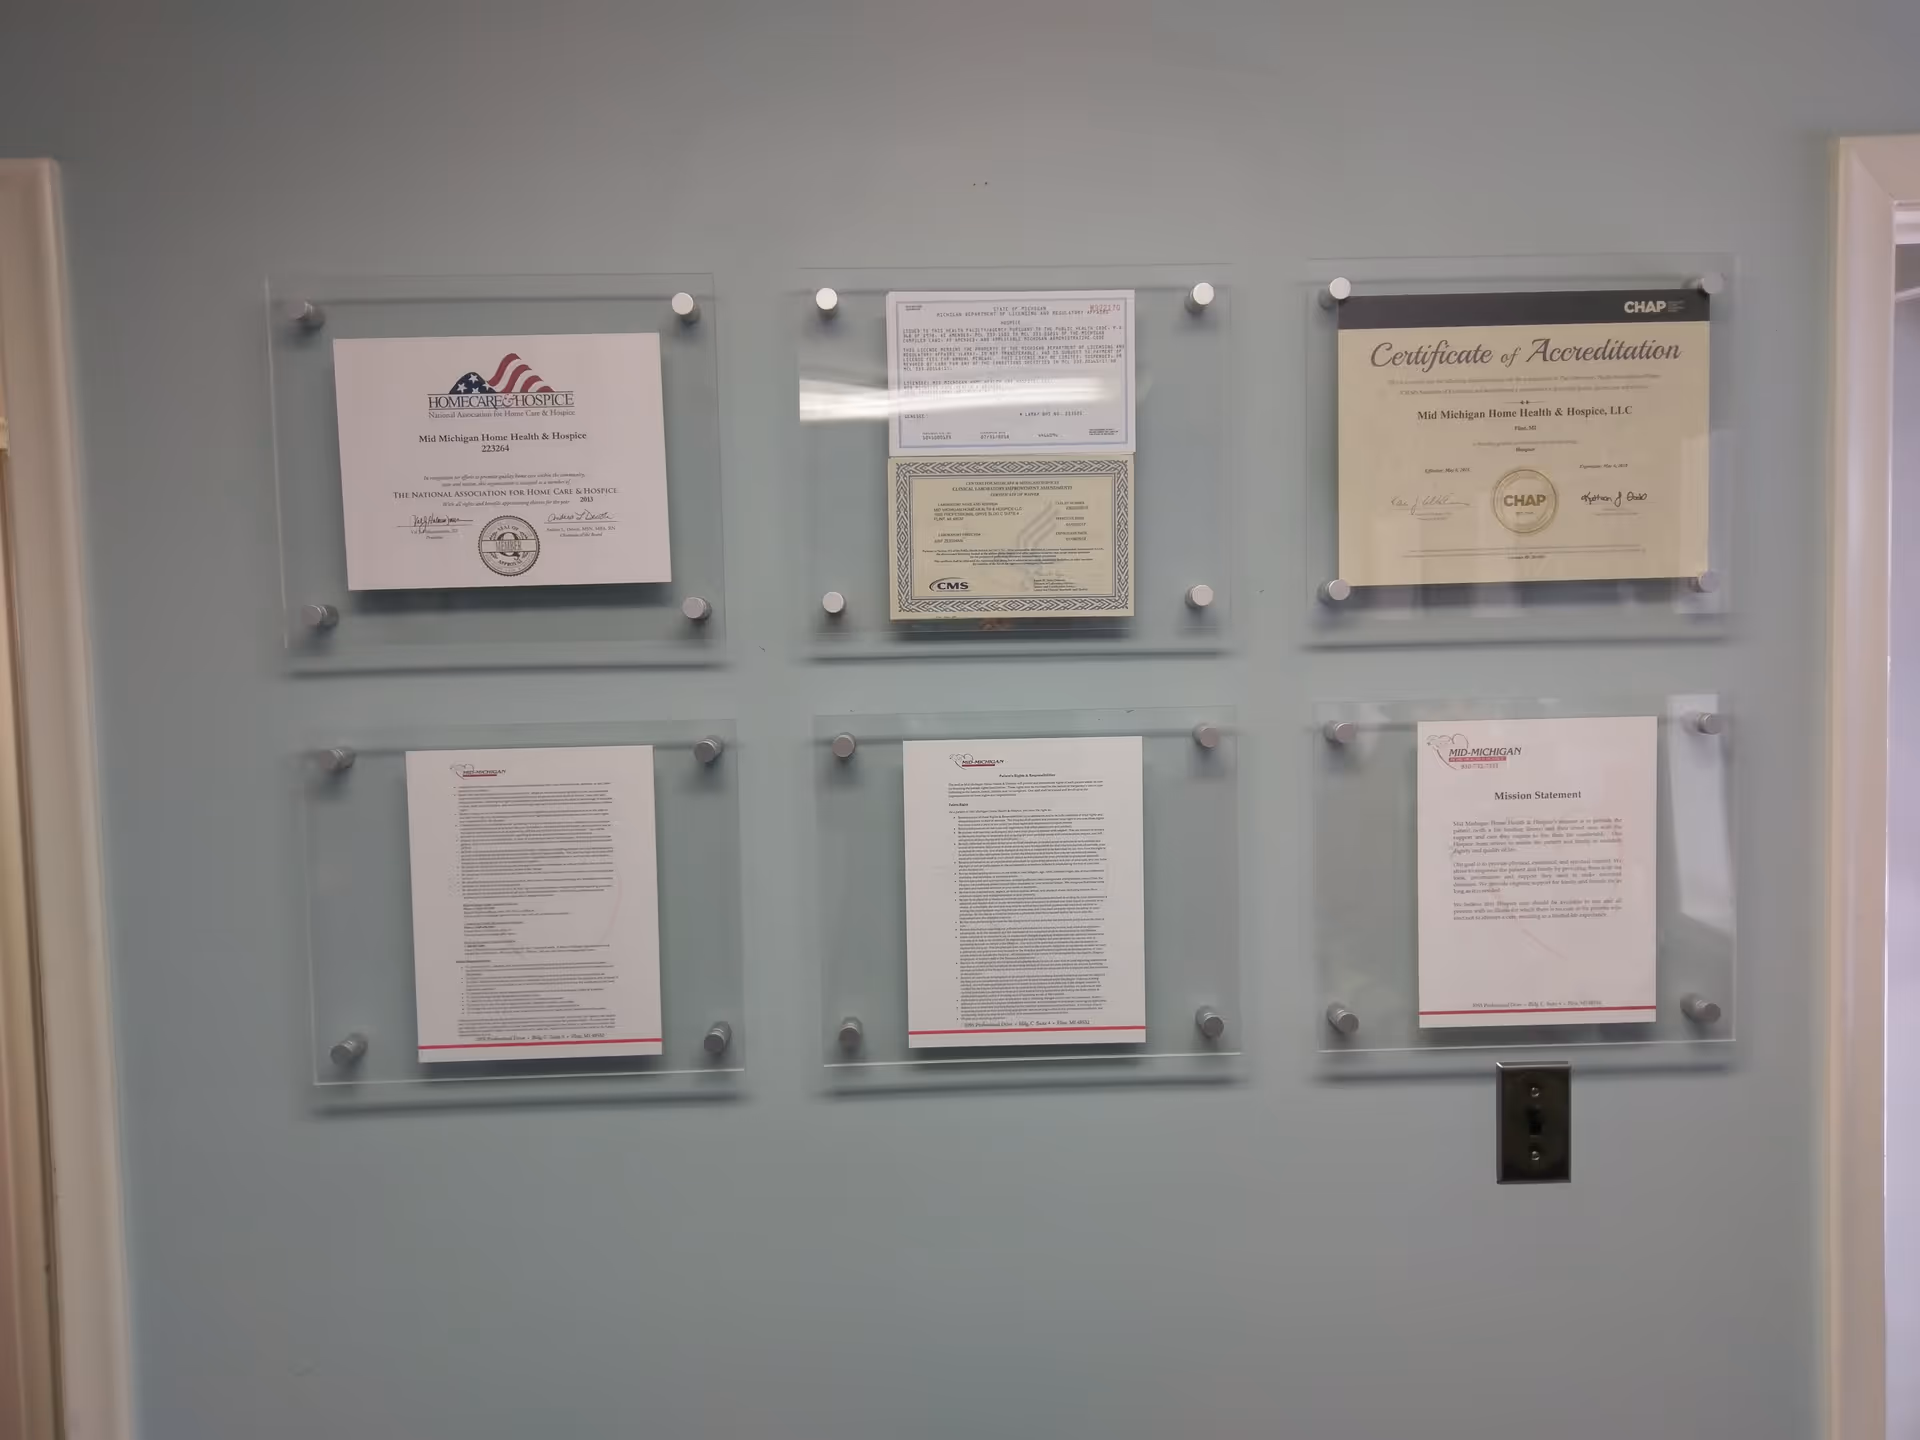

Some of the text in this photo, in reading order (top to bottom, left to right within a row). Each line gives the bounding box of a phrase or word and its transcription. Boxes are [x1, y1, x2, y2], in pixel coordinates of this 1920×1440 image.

[1624, 300, 1667, 313] CHAP
[1370, 338, 1682, 373] Certificate of Accreditation
[428, 411, 456, 419] National
[494, 410, 503, 418] for
[550, 409, 576, 418] Hospice
[1417, 406, 1633, 421] Mid Michigan Home Health & Hospice, LLC
[419, 431, 587, 444] Mid Michigan Home Health & Hospice
[481, 444, 510, 453] 223264
[411, 491, 453, 499] NATIONAL
[454, 490, 507, 498] ASSOCIATION
[527, 488, 550, 496] HOME
[553, 487, 574, 495] CARE
[575, 487, 582, 495] &
[583, 487, 617, 495] HOSPICE
[1503, 494, 1547, 507] CHAP
[937, 582, 969, 590] CMS
[1448, 747, 1522, 757] MID-MICHIGAN
[1494, 790, 1582, 800] Mission Statement
